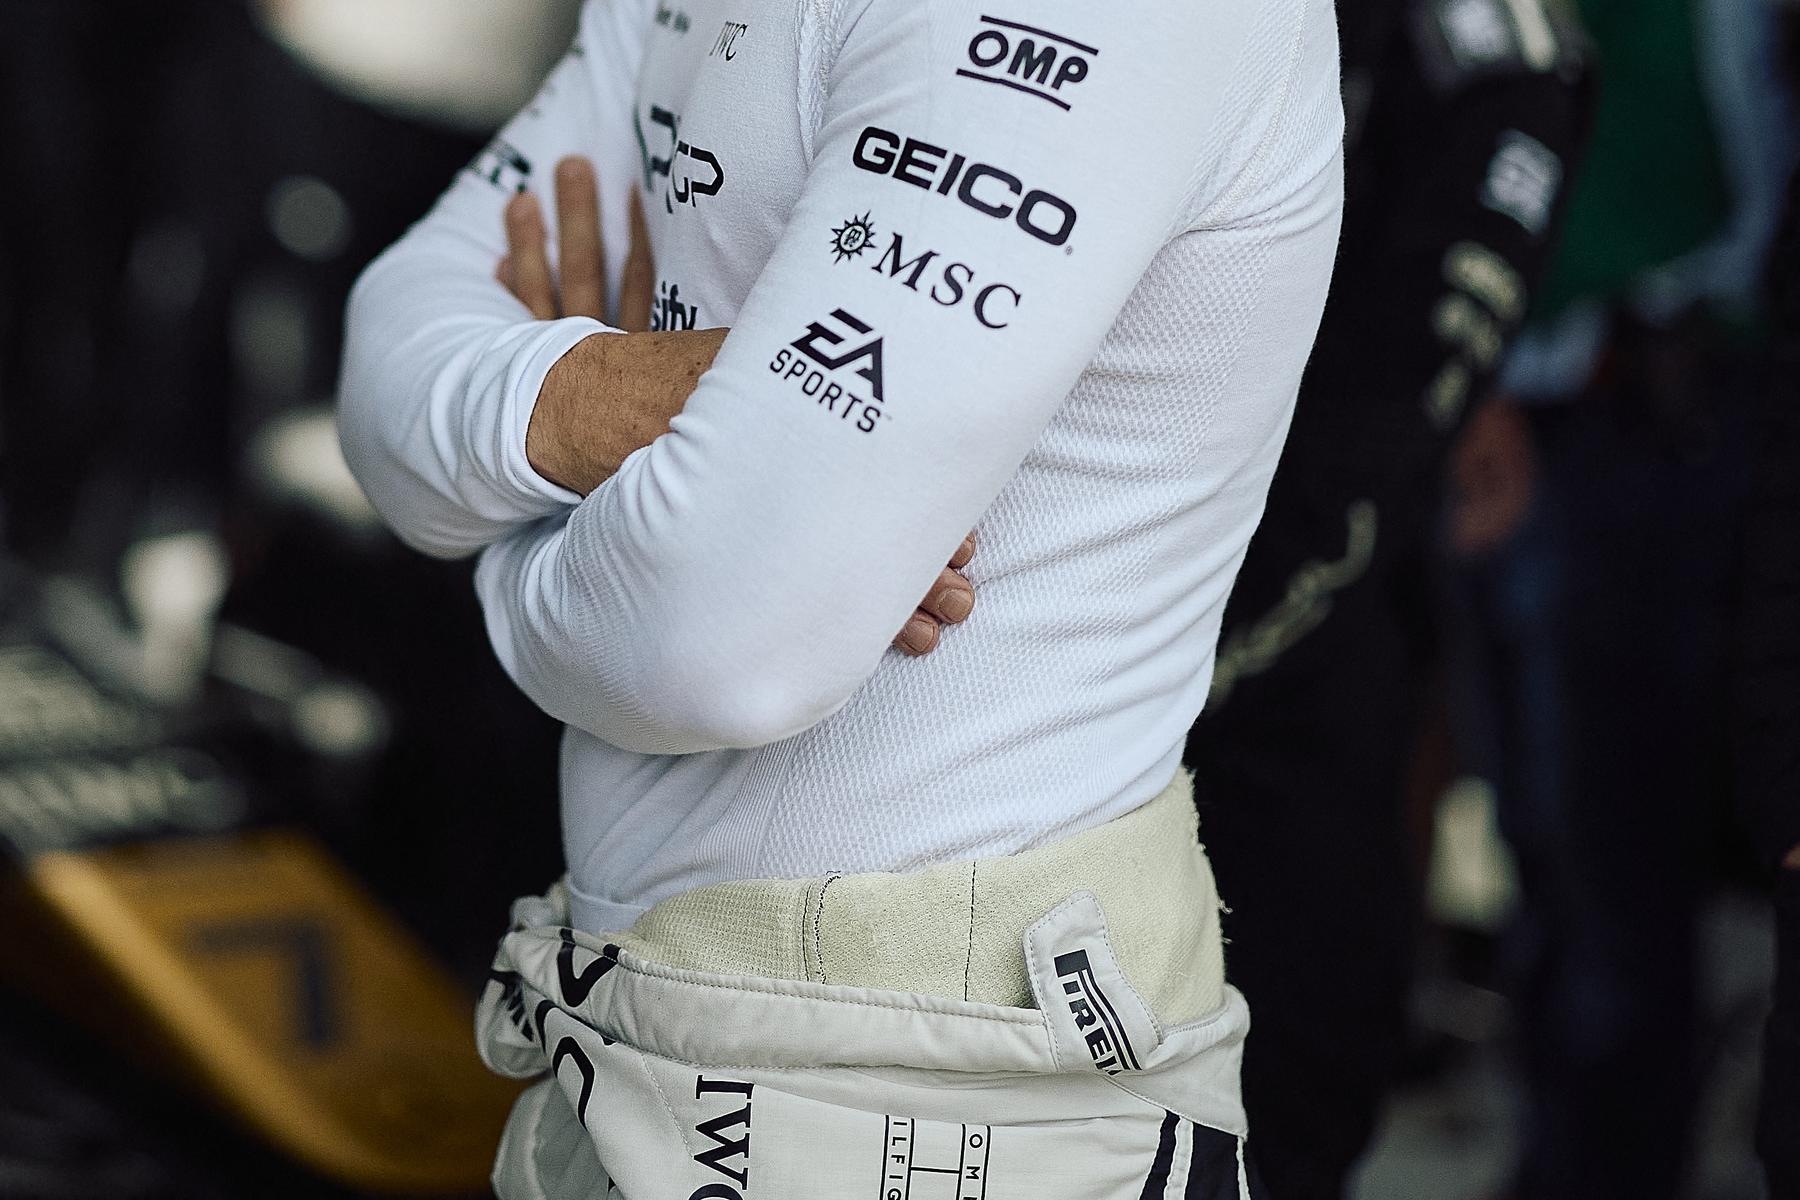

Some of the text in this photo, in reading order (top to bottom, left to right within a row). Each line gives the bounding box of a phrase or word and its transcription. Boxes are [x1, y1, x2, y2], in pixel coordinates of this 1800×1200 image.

[968, 30, 1089, 90] OMP
[852, 126, 1077, 246] GEICO
[871, 232, 1021, 329] MSC
[769, 348, 882, 434] SPORTS
[790, 308, 885, 402] EA
[688, 1074, 754, 1200] IW
